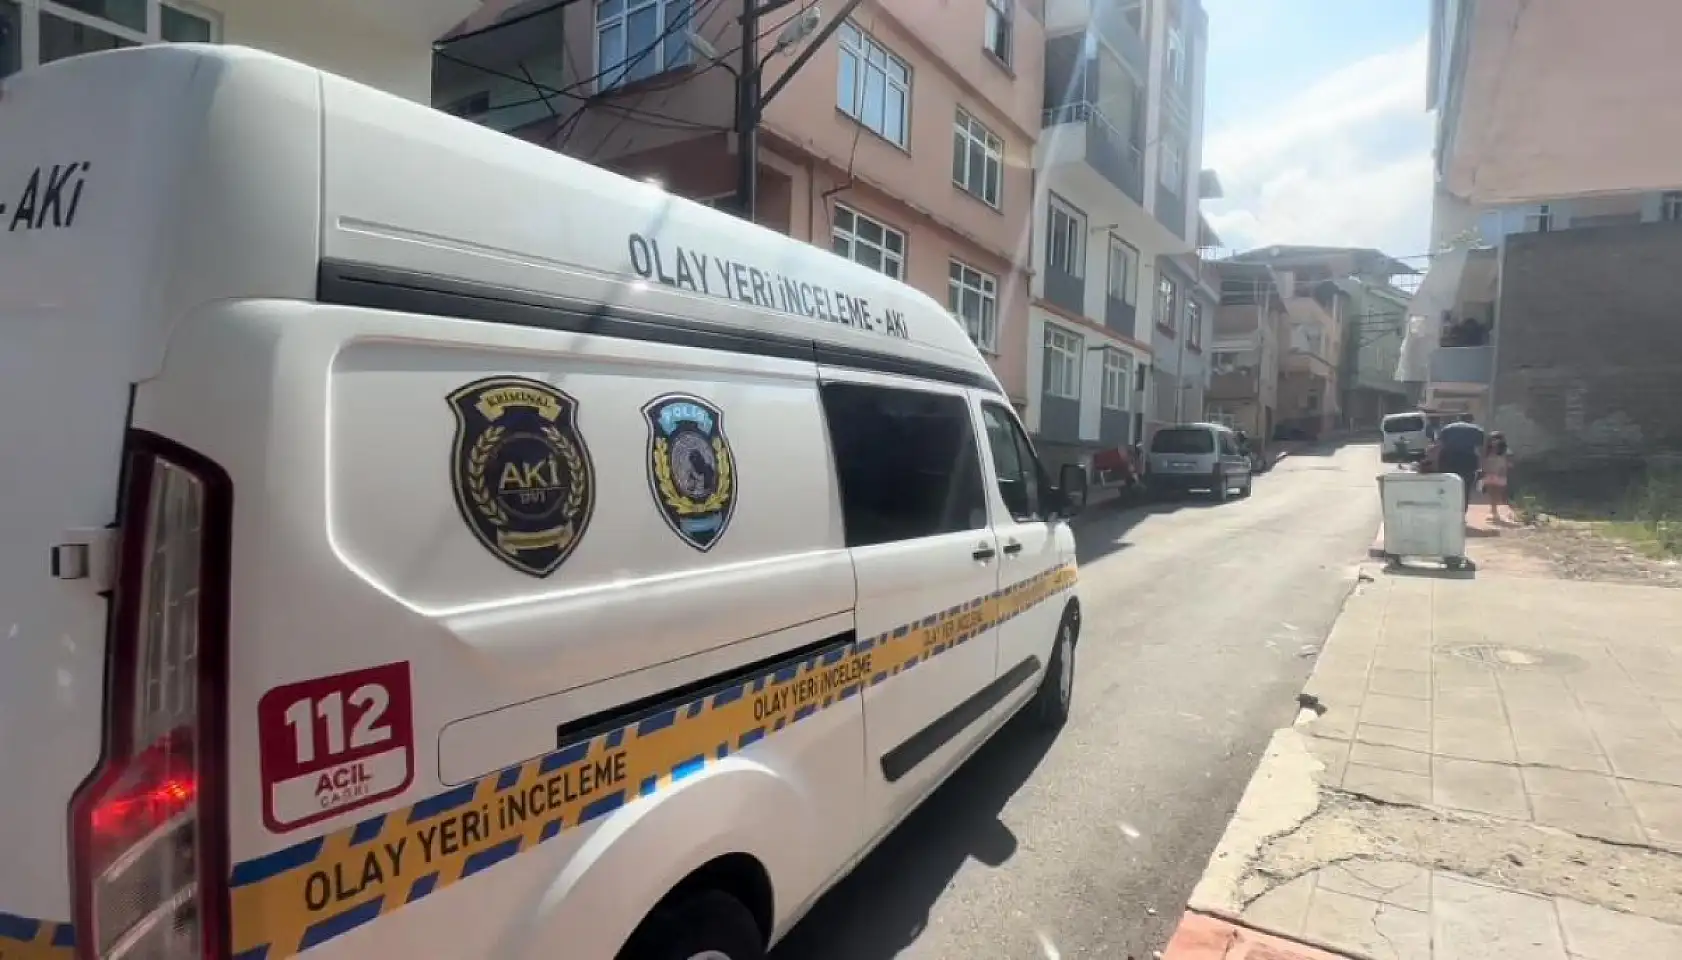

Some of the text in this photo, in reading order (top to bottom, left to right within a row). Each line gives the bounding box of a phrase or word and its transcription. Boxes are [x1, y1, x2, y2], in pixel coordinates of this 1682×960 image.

[629, 232, 708, 295] OLAY
[284, 683, 392, 764] 112
[754, 686, 789, 721] OLAY
[304, 836, 407, 911] OLAY
